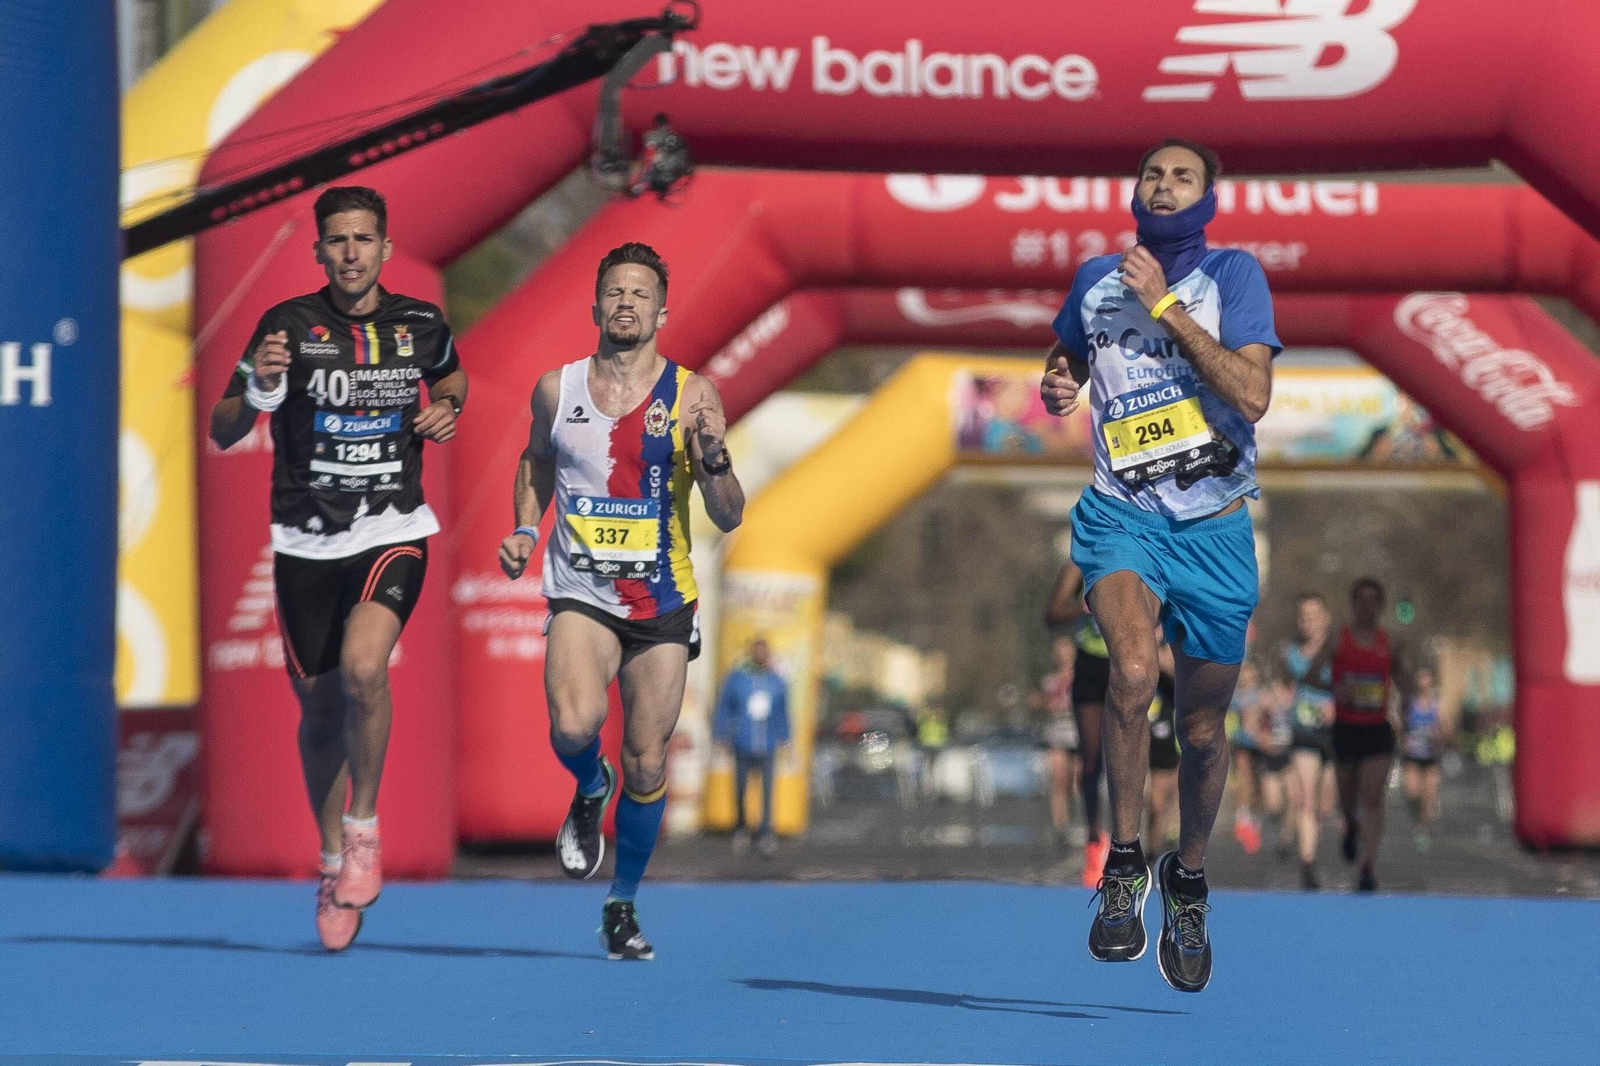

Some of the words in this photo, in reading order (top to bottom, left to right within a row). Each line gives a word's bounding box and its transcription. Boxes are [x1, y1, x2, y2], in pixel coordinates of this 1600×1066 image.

[658, 40, 799, 92] new
[812, 35, 1098, 101] balance
[357, 364, 423, 381] MARATÓN
[306, 368, 350, 407] 40
[356, 389, 378, 399] LOS
[372, 380, 407, 390] SEVILLA
[1126, 384, 1184, 412] ZURICH
[343, 417, 392, 433] ZURICH
[1135, 417, 1175, 446] 294
[335, 442, 382, 462] 1294
[594, 502, 648, 516] ZURICH
[594, 527, 629, 545] 337
